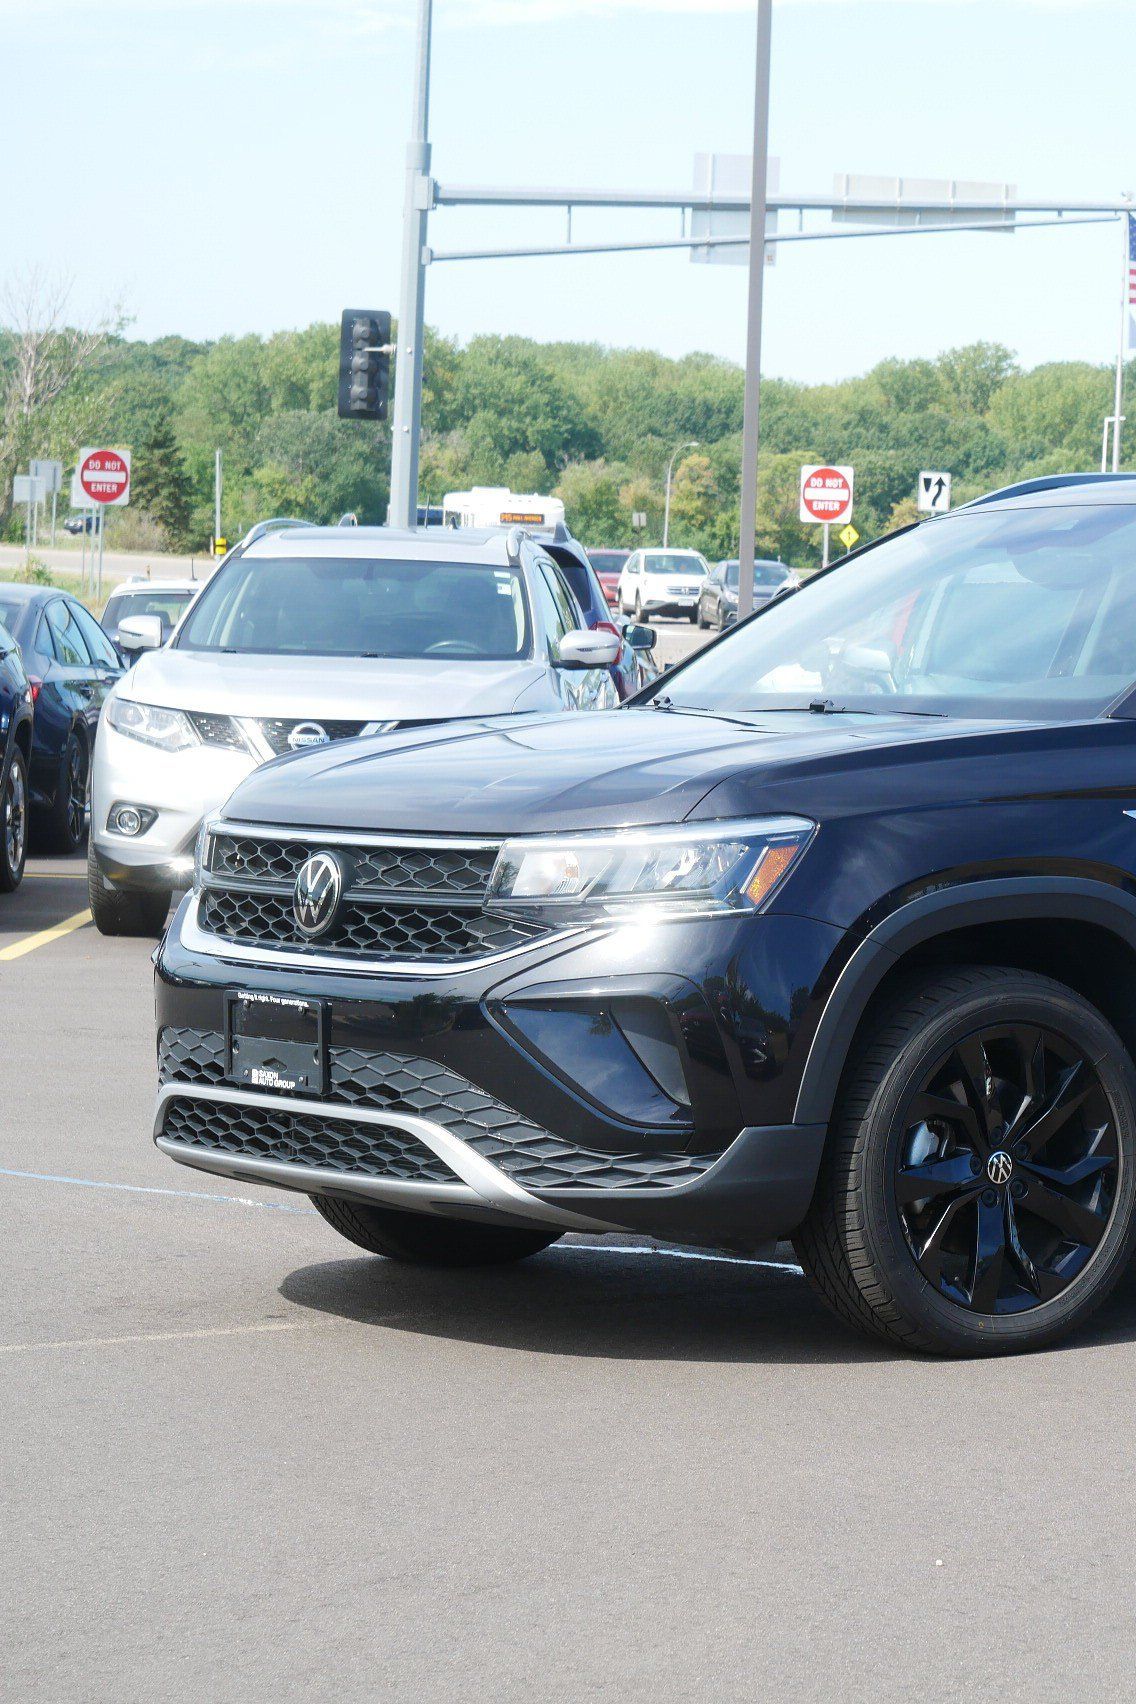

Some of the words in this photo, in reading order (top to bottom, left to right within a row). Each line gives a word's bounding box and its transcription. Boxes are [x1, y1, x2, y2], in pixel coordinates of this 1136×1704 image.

[89, 460, 100, 470] DO
[105, 460, 121, 471] NOT
[91, 482, 118, 493] ENTER
[810, 477, 823, 488] DO
[825, 478, 844, 489] NOT
[812, 501, 840, 512] ENTER
[292, 736, 326, 744] NISSAN
[258, 1077, 274, 1087] AUTO
[274, 1079, 296, 1090] GROUP
